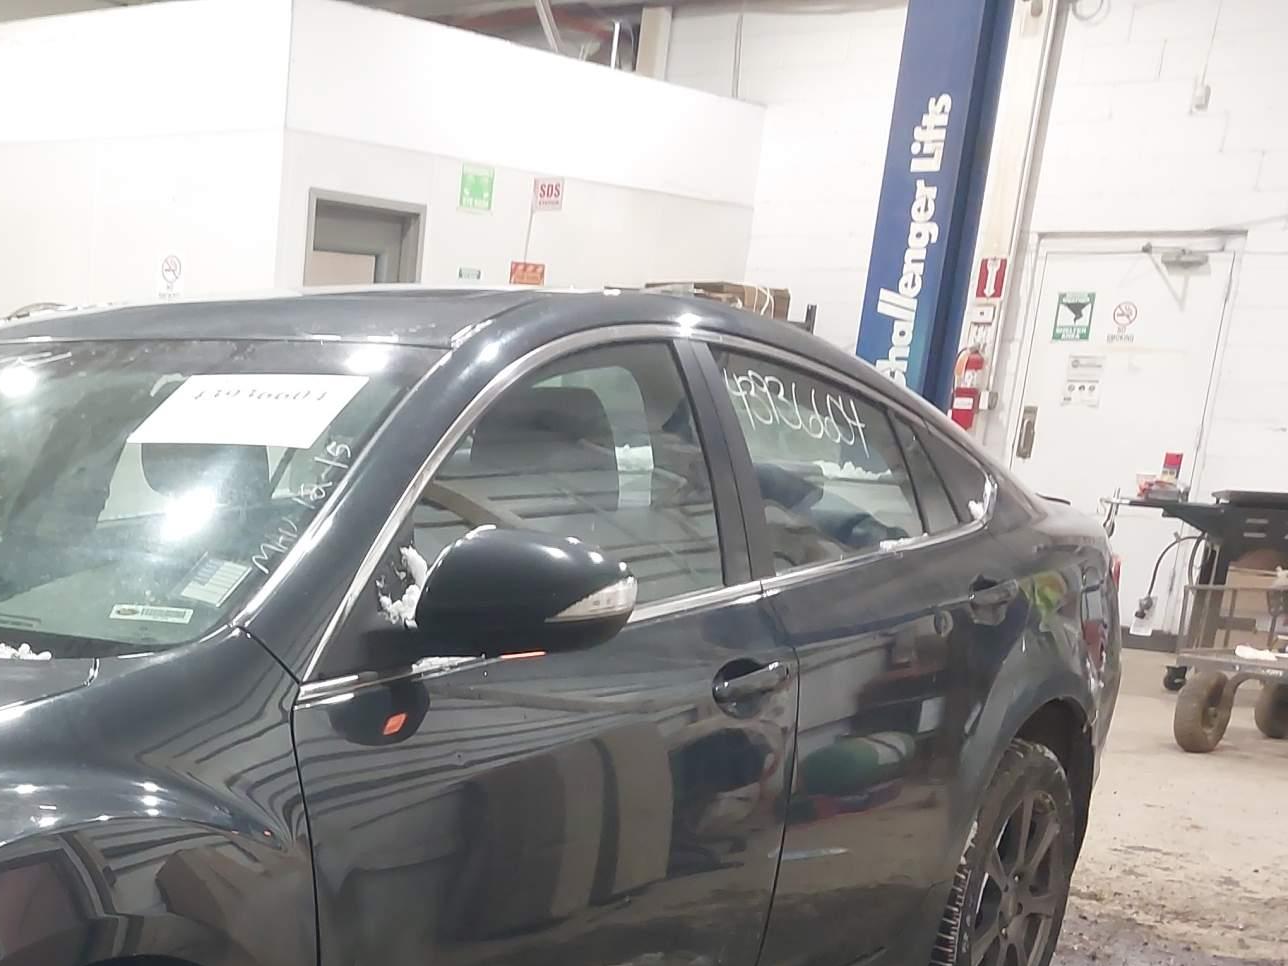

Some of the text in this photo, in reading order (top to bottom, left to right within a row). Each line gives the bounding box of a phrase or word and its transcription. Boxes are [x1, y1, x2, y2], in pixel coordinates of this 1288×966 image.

[909, 93, 952, 172] Lifts
[539, 183, 560, 199] SDS
[723, 367, 870, 459] 43936604
